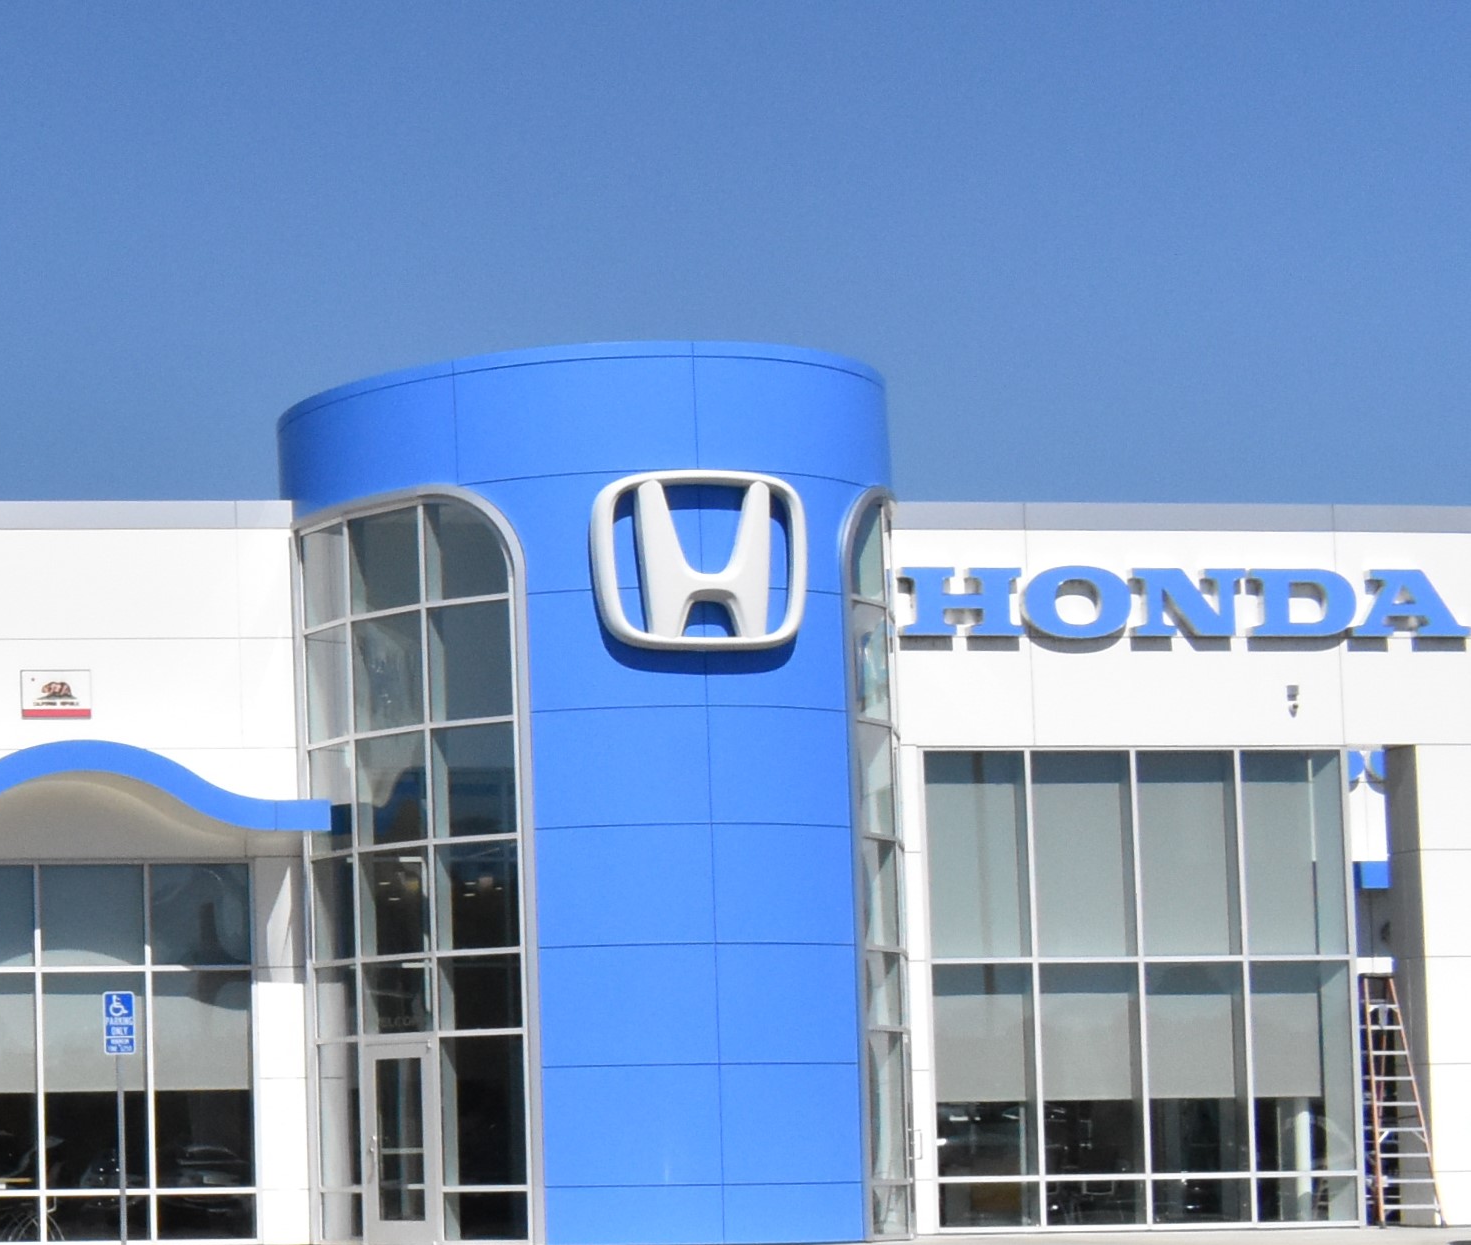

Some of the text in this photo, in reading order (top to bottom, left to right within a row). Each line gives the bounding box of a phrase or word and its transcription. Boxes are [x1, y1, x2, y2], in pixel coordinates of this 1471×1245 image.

[899, 565, 1469, 637] HONDA
[106, 1016, 134, 1026] PARKING
[110, 1026, 129, 1036] ONLY
